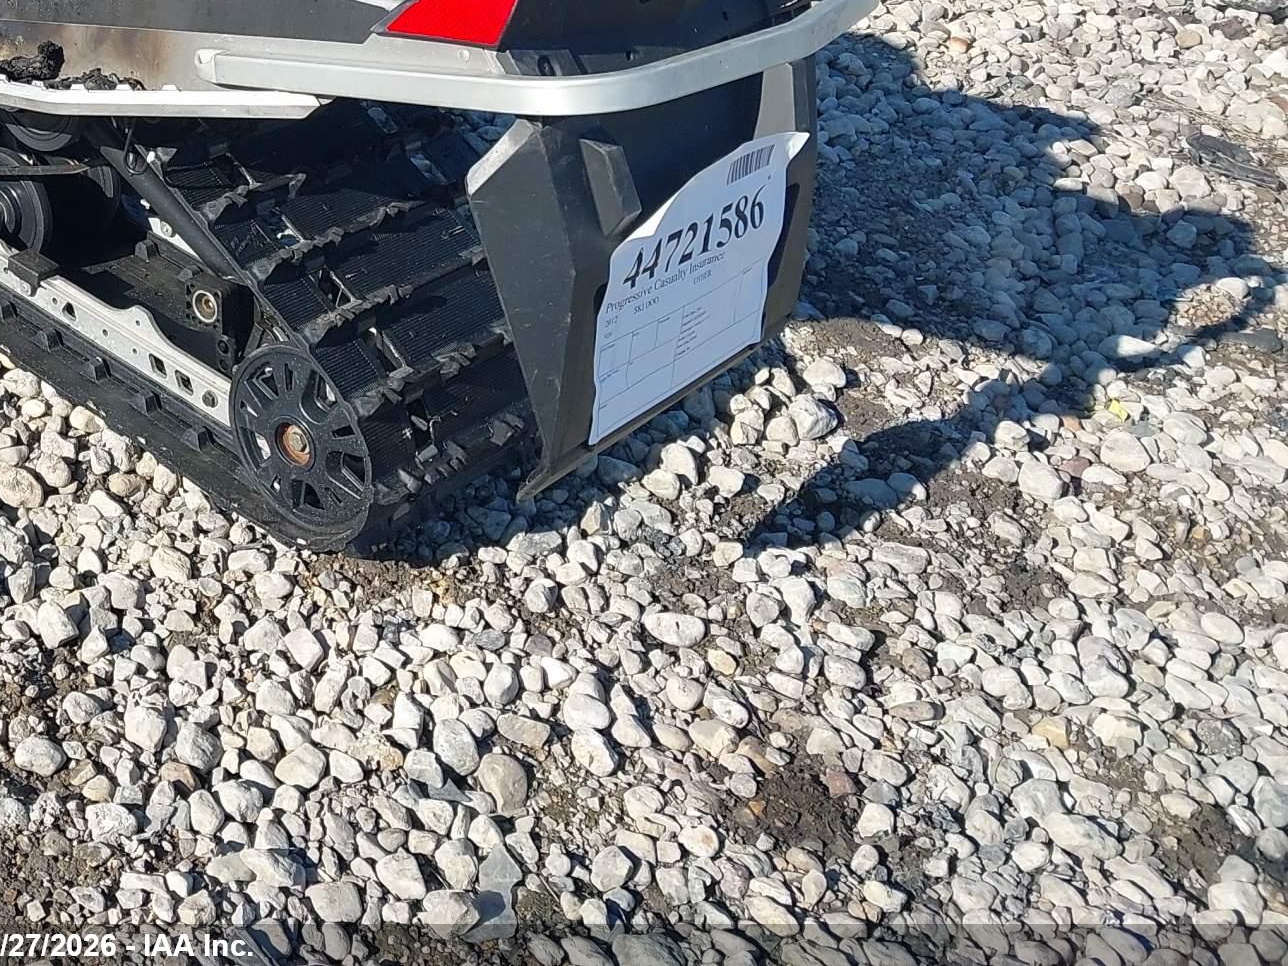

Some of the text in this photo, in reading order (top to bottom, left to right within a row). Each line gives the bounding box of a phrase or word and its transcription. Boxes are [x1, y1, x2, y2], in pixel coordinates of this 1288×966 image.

[623, 184, 767, 289] 44721586
[605, 286, 653, 315] Progressive
[654, 267, 687, 291] Casualty
[689, 251, 726, 275] Insurance
